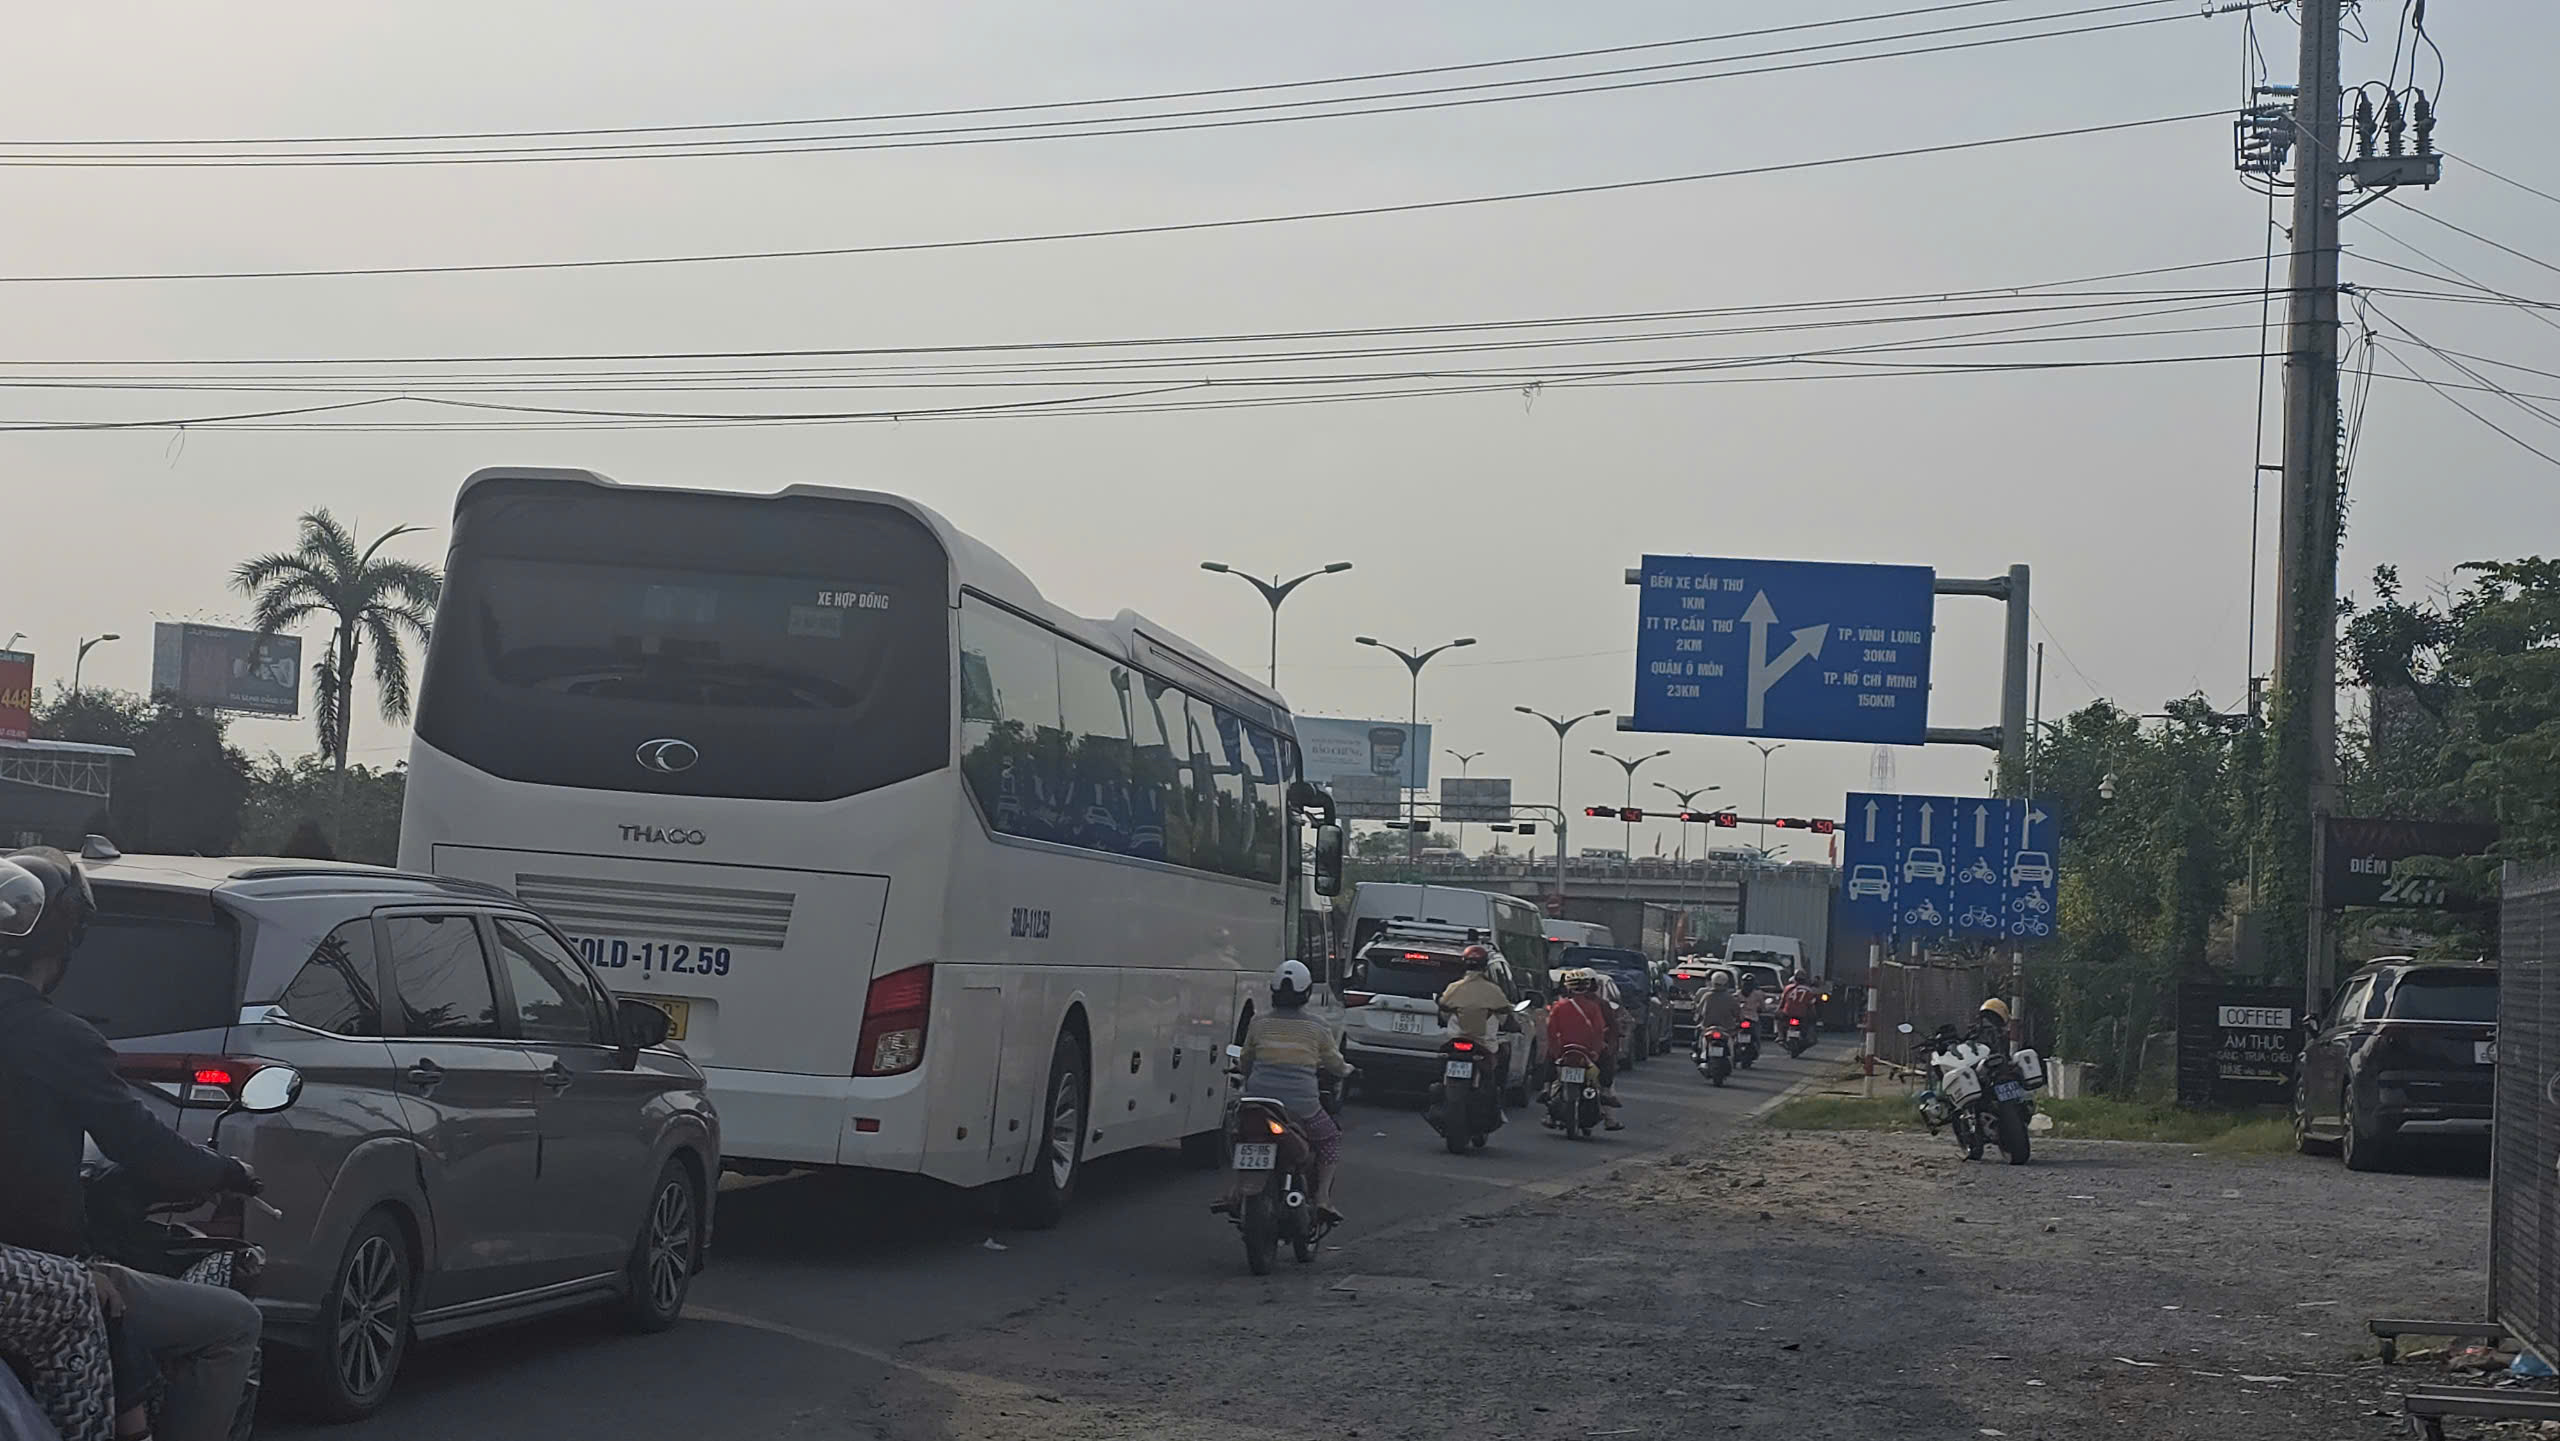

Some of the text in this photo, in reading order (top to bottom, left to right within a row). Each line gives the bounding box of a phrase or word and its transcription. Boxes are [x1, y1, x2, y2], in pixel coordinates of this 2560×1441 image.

[1676, 576, 1691, 590] XE
[1723, 578, 1744, 592] THƠ
[817, 591, 832, 606] XE
[834, 591, 857, 609] HỢP
[1681, 597, 1705, 610] 1KM
[1646, 617, 1660, 630] TT
[1712, 619, 1734, 633] THƠ
[1676, 639, 1703, 652] 2KM
[1890, 630, 1921, 645] LONG
[1863, 649, 1896, 663] 30KM
[1886, 674, 1918, 689] MINH
[1667, 684, 1700, 698] 23KM
[1857, 694, 1896, 709] 150KM
[618, 824, 706, 845] THACO
[2350, 853, 2386, 874] ĐIỂM
[569, 937, 731, 976] 0LD-112.59
[1788, 988, 1808, 1004] 47
[2227, 1009, 2283, 1026] COFFEE
